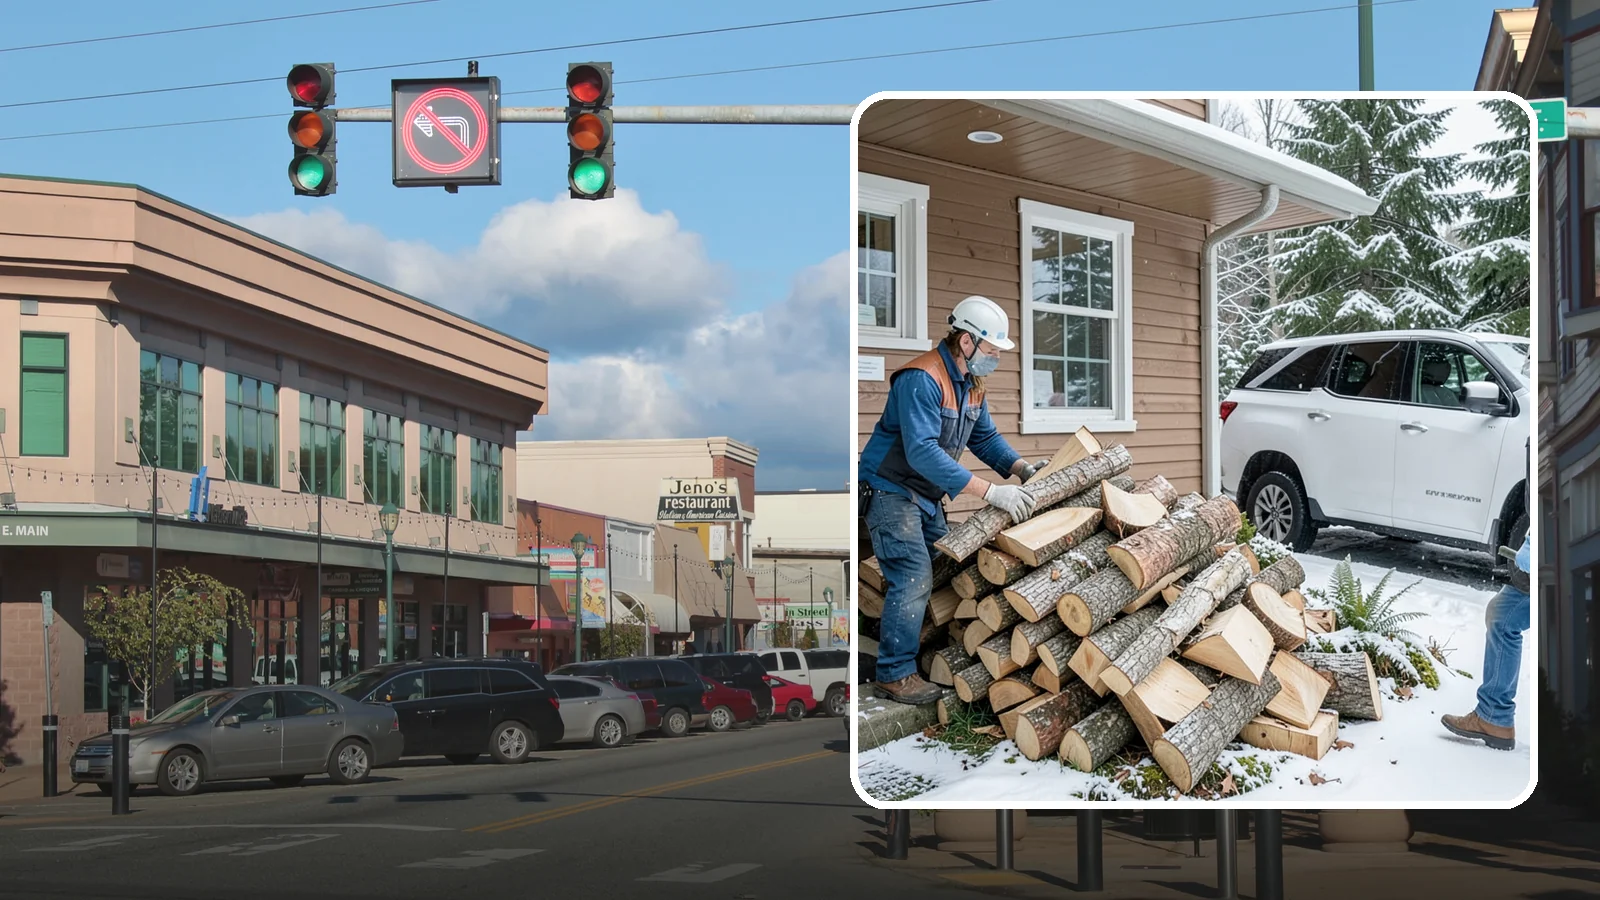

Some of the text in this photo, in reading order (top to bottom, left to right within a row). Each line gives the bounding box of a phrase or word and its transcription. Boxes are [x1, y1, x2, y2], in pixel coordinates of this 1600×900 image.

[670, 480, 727, 494] Jeno's
[665, 496, 731, 508] restaurant
[659, 510, 681, 519] Italian
[686, 510, 714, 519] American
[715, 510, 737, 519] Cuisine
[2, 525, 49, 536] E. MAIN
[786, 608, 828, 617] in Street
[791, 619, 823, 627] lass
